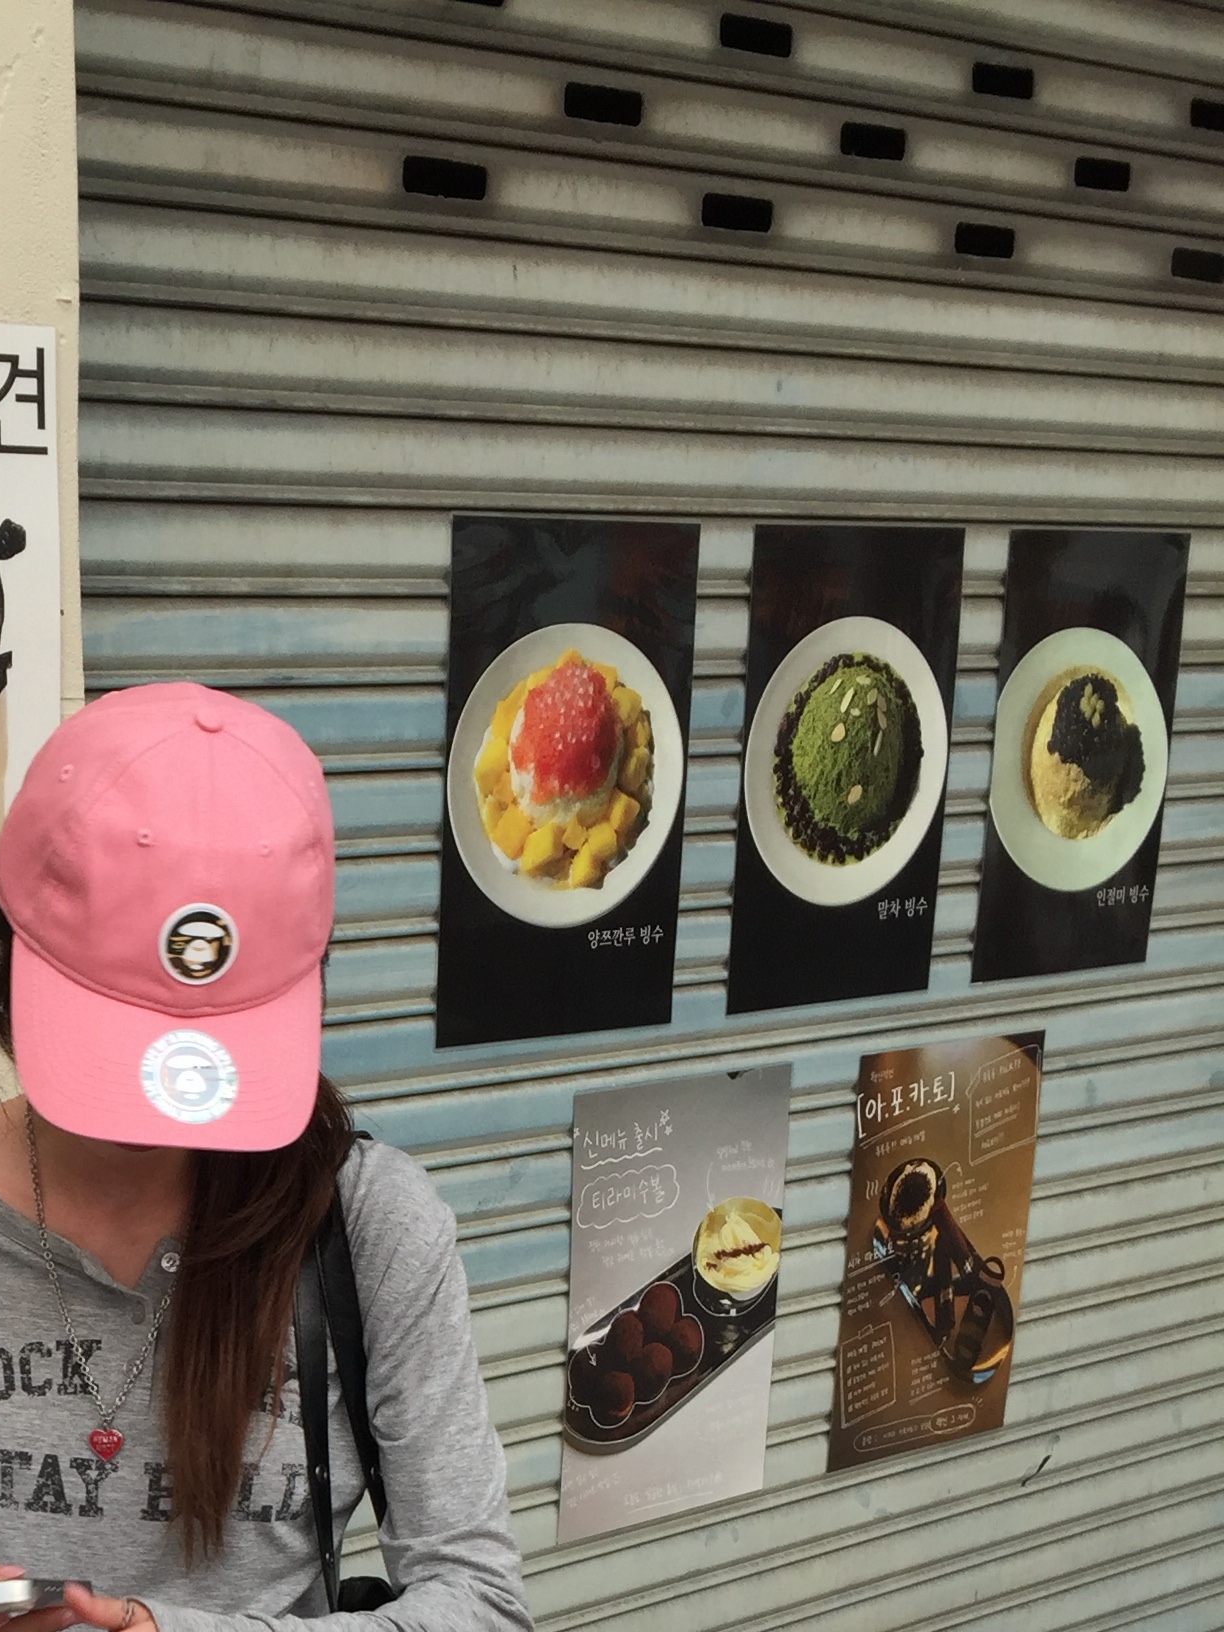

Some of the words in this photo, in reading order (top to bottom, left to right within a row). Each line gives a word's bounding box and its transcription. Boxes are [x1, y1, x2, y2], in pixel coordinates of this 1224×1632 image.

[877, 898, 901, 922] 말차
[905, 895, 928, 918] 빙수
[1096, 886, 1126, 907] 인절미
[1129, 884, 1149, 904] 빙수
[640, 924, 664, 945] 빙수
[582, 1128, 627, 1159] 신메뉴
[633, 1121, 658, 1151] 출시
[591, 1173, 666, 1210] 티라미수볼
